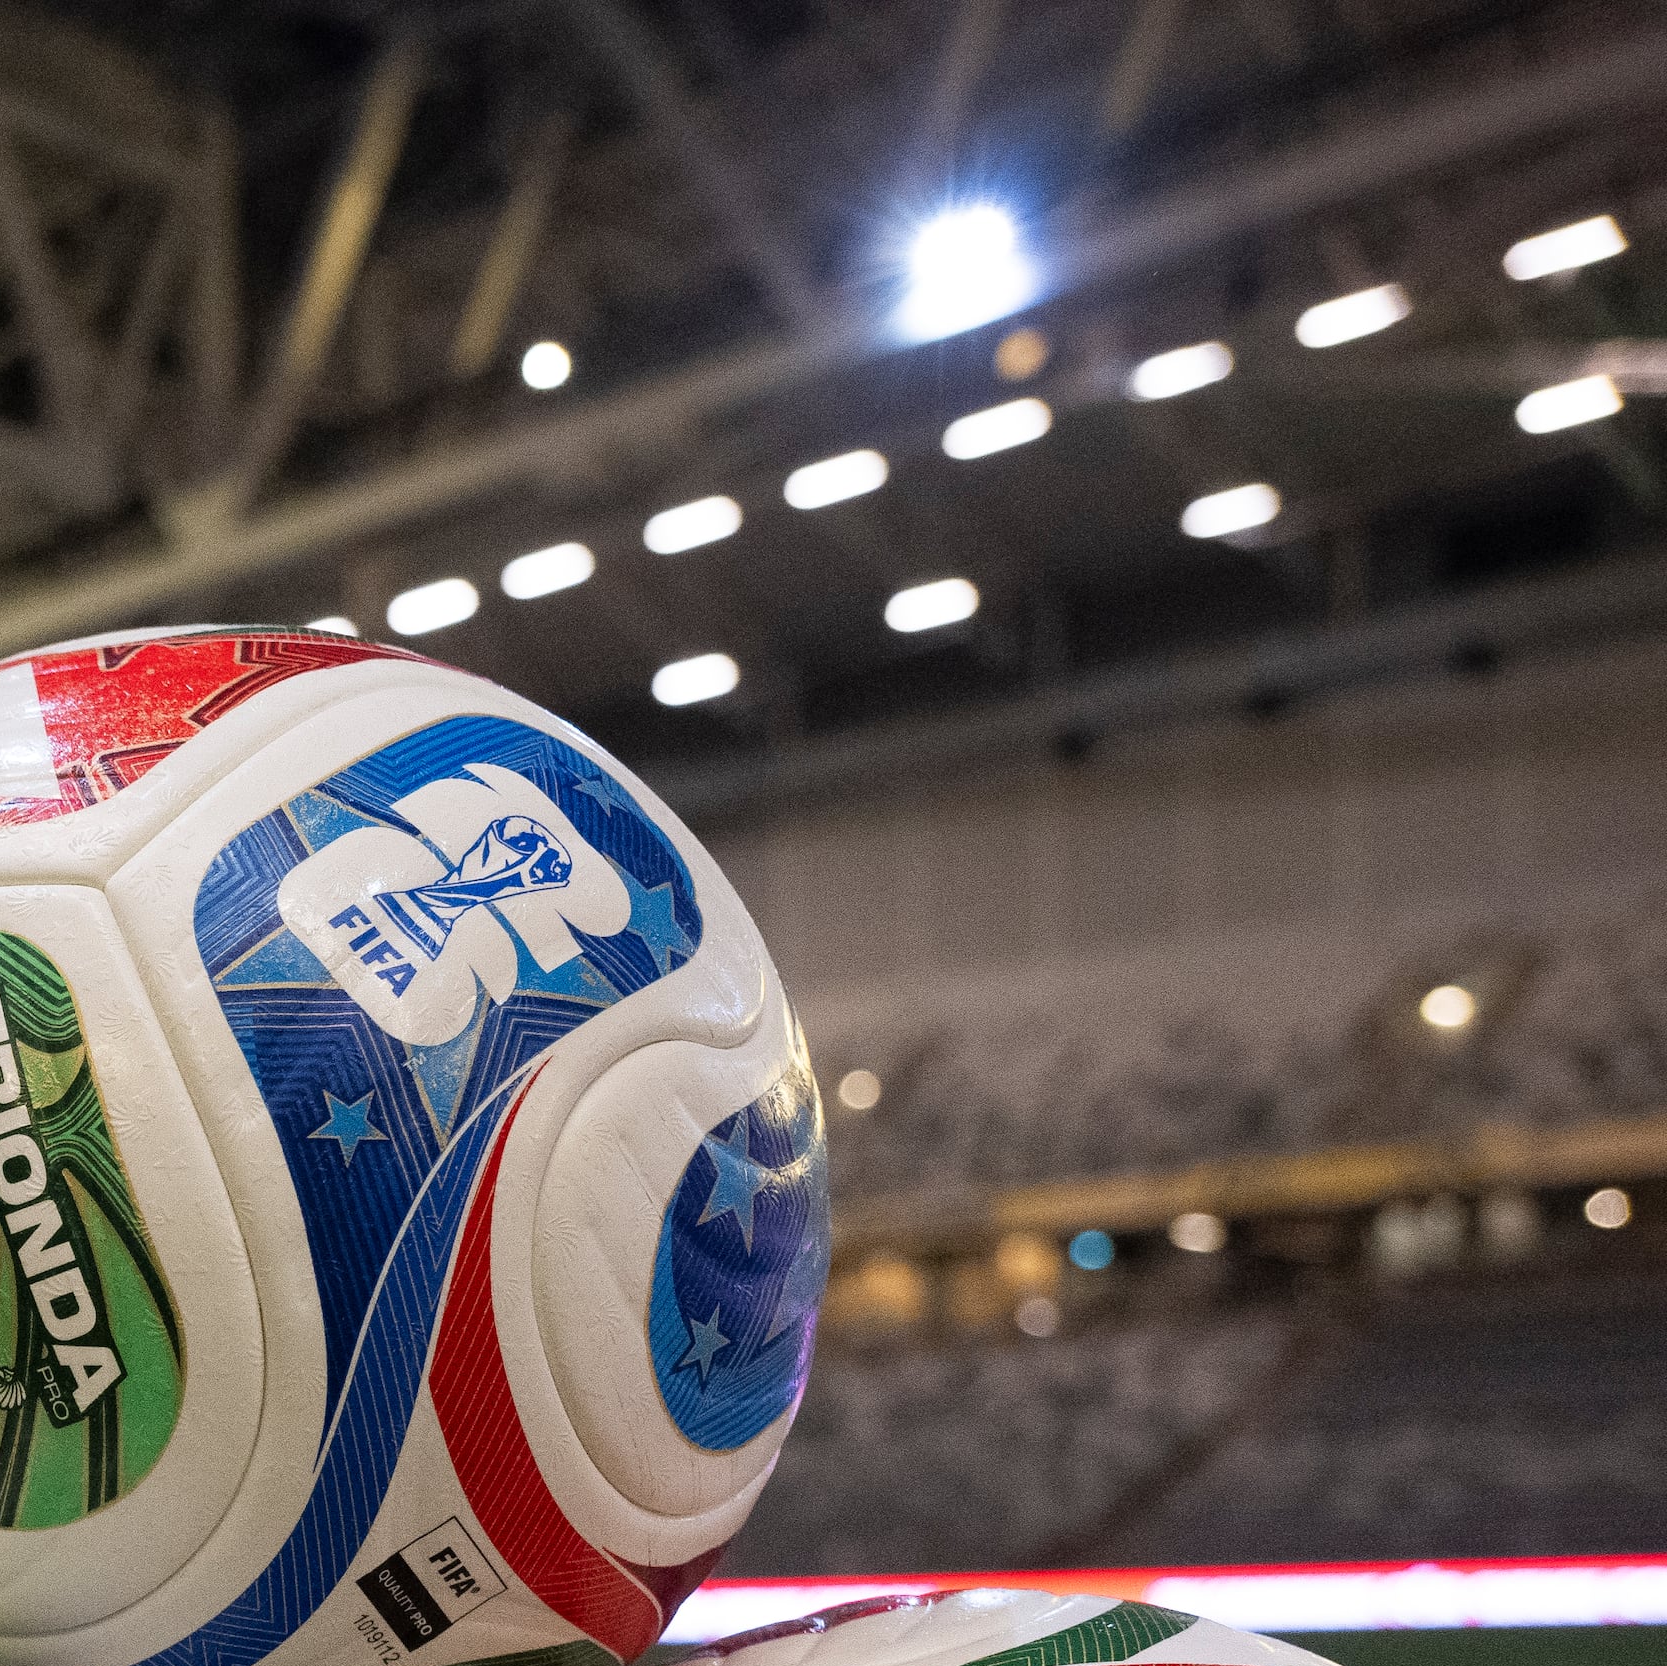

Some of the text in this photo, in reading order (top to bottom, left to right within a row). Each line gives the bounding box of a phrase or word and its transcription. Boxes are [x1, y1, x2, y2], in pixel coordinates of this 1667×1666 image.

[328, 904, 420, 999] FIFA
[38, 1364, 69, 1422] PRO
[377, 1568, 433, 1637] QUALITY PRO
[353, 1613, 402, 1666] 1019112
